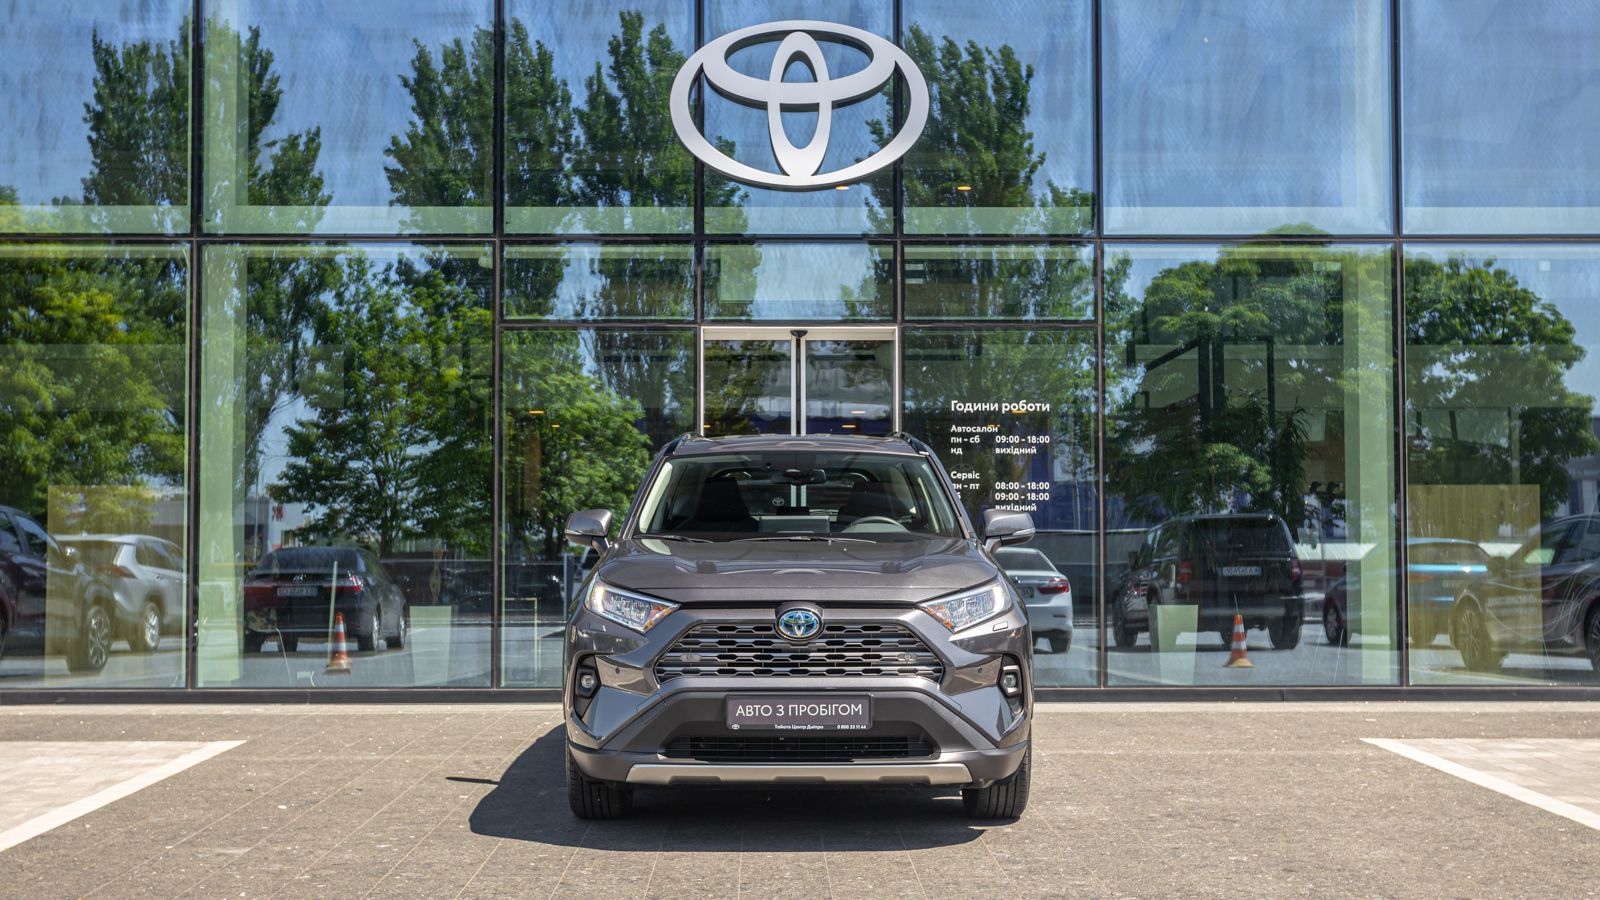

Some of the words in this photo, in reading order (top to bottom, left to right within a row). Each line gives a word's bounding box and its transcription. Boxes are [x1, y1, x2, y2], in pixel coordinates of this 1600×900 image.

[950, 400, 999, 413] Години
[1001, 400, 1050, 414] роботи
[950, 425, 998, 433] Автосалон
[969, 435, 980, 443] сб
[995, 435, 1020, 444] 09:00
[1027, 435, 1050, 444] 18:00
[950, 447, 963, 455] нд
[995, 446, 1037, 455] вихідний
[950, 470, 980, 481] Сервіс
[995, 482, 1020, 490] 08:00
[1027, 482, 1050, 490] 18:00
[995, 492, 1020, 501] 09:00
[1027, 492, 1050, 501] 18:00
[995, 503, 1037, 512] вихідний
[736, 705, 772, 717] АВТО
[776, 704, 785, 717] З
[788, 704, 862, 716] ПРОБІГОМ
